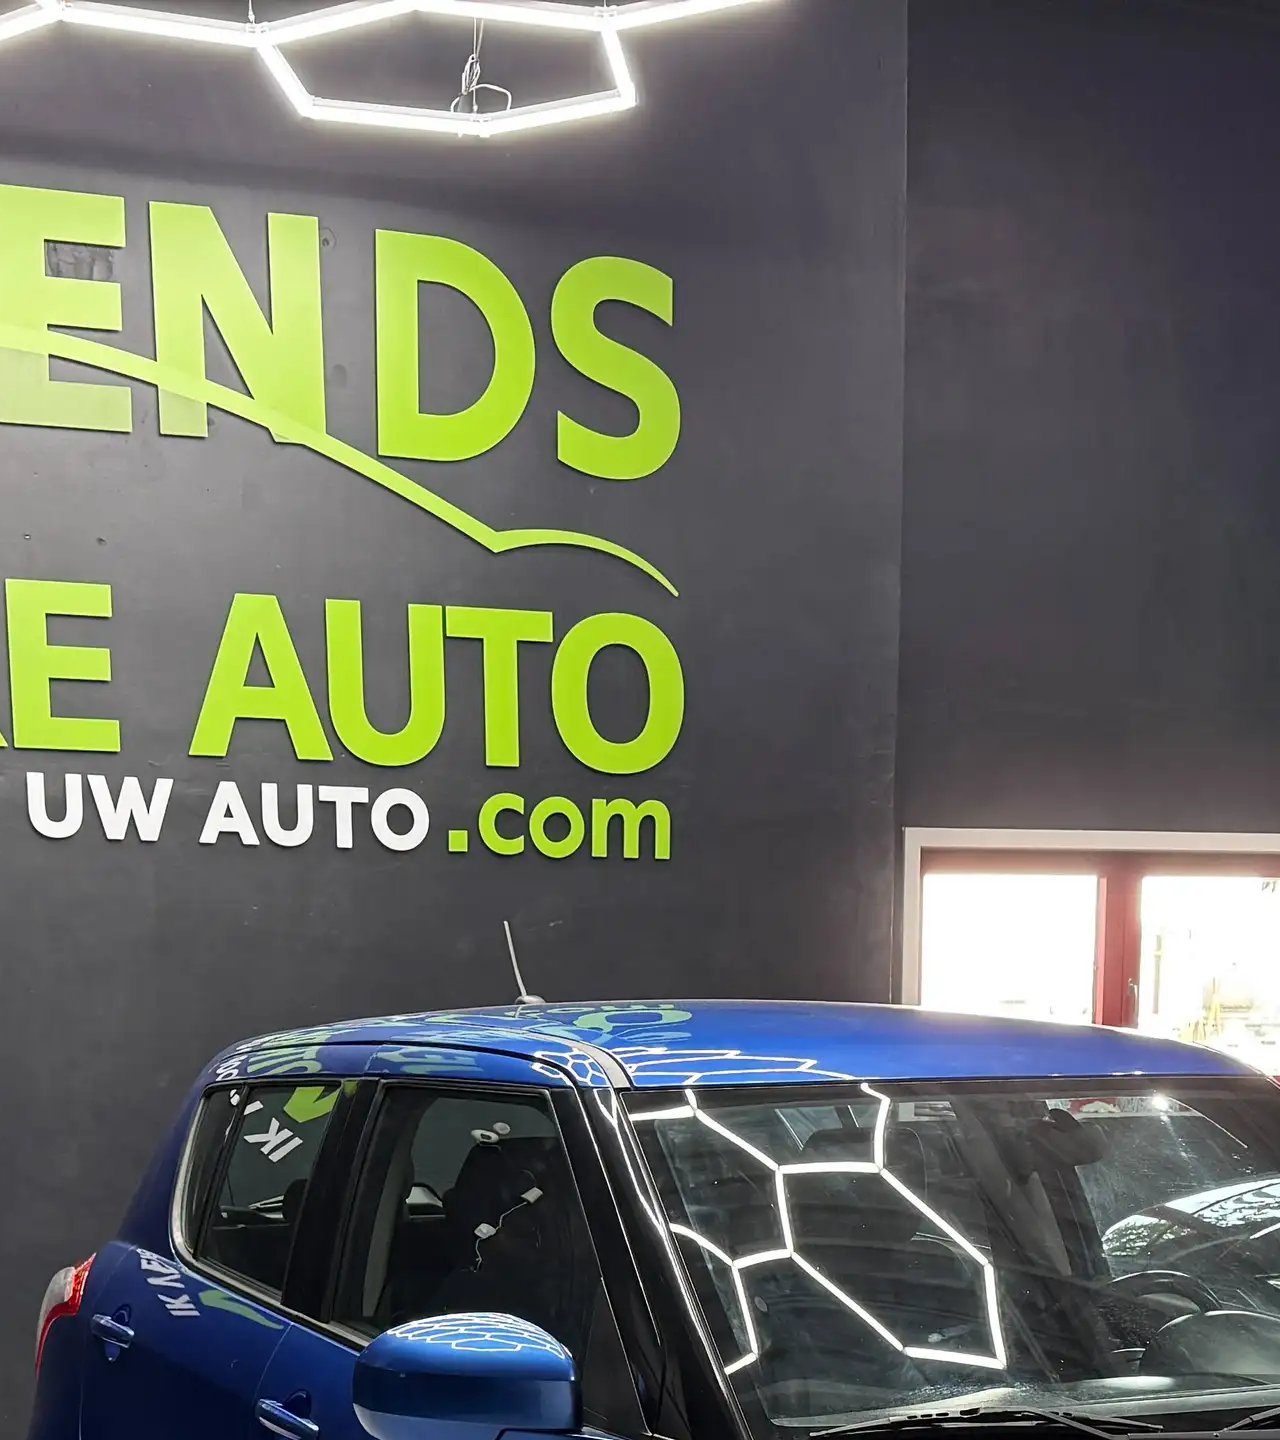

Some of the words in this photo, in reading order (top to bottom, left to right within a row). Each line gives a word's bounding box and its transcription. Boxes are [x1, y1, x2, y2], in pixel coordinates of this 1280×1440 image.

[188, 593, 686, 774] AUTO
[25, 771, 175, 842] UW
[197, 781, 430, 851] AUTO
